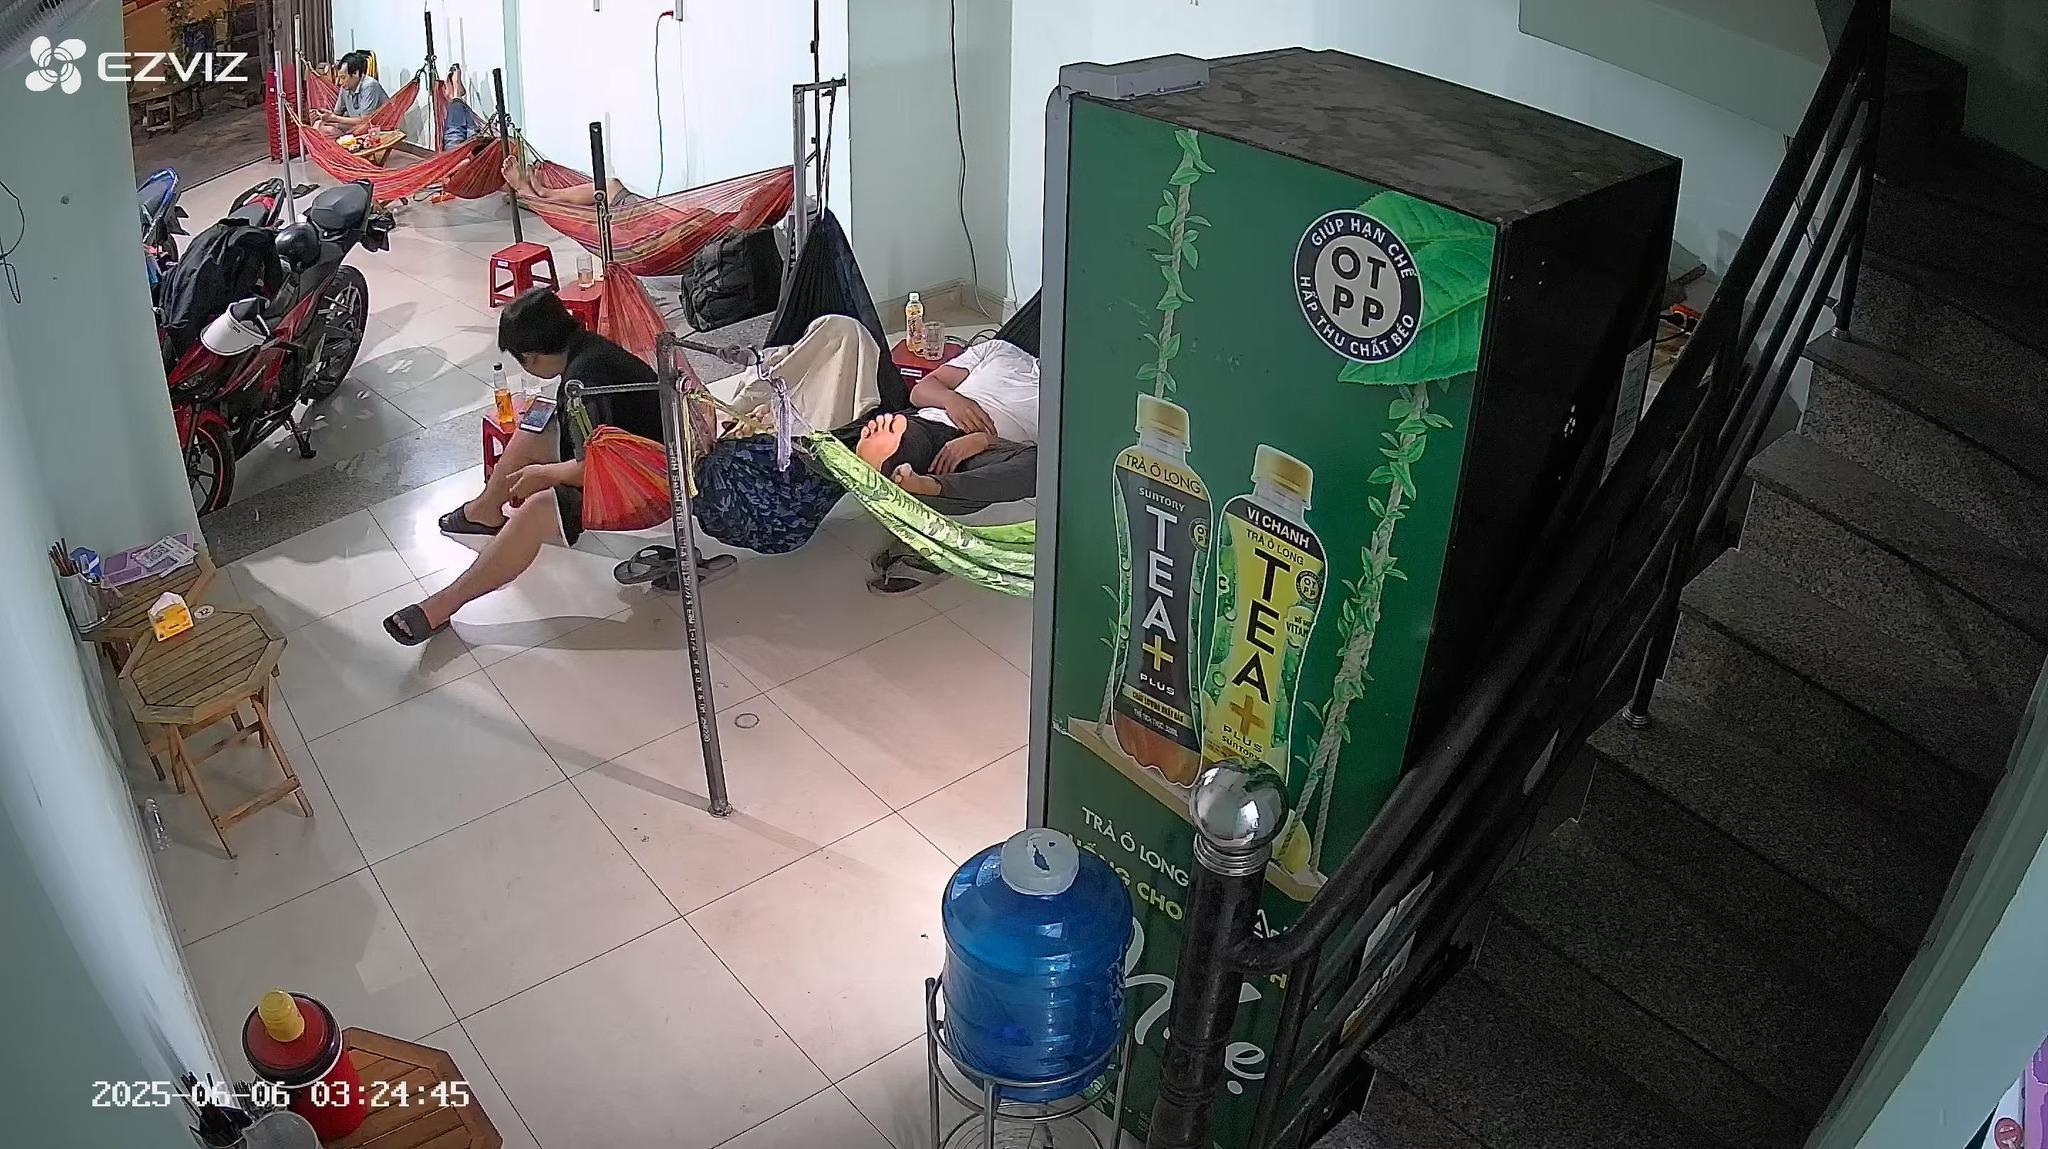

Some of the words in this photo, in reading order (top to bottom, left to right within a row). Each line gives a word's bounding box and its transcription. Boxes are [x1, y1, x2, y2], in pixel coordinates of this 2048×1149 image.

[1311, 218, 1344, 246] GIÚP
[1350, 218, 1386, 244] HẠN
[1387, 243, 1419, 279] CHẾ
[1300, 276, 1319, 312] HẤP
[1316, 315, 1345, 347] THU
[1350, 337, 1390, 357] CHẤT
[1390, 314, 1414, 347] BÉO
[1126, 454, 1147, 472] TRÀ
[1150, 463, 1161, 477] Ô
[1164, 469, 1201, 493] LONG
[1139, 487, 1186, 512] SUNTORY
[1246, 528, 1265, 546] TRÀ
[1277, 545, 1304, 566] LONG
[1247, 506, 1260, 525] VỊ
[1262, 515, 1310, 549] CHANH
[1140, 672, 1175, 696] PLUS
[1223, 724, 1263, 752] PLUS
[1082, 806, 1117, 843] TRÀ
[1120, 831, 1136, 852] Ô
[1140, 844, 1189, 887] LONG
[1137, 881, 1183, 920] CHO
